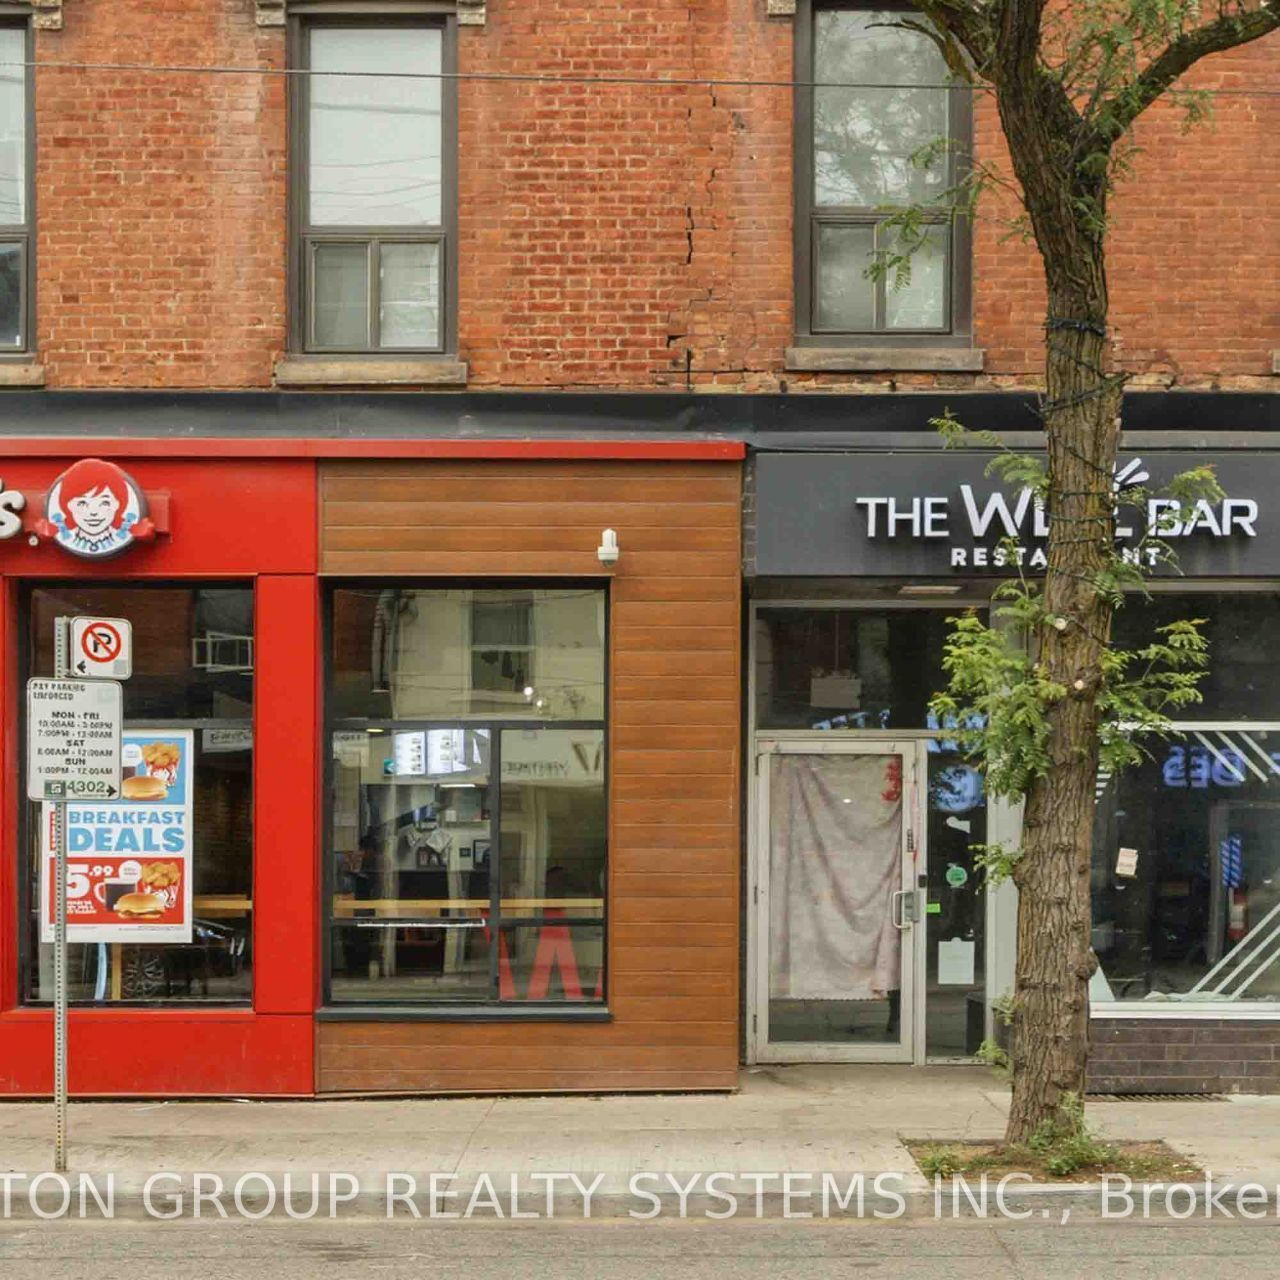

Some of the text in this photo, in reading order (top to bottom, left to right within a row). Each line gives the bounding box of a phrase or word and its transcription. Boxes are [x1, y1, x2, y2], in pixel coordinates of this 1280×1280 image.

[855, 497, 950, 538] THE
[1147, 498, 1259, 537] BAR
[951, 548, 1161, 567] RESTANT
[67, 781, 106, 793] 4302
[69, 811, 185, 824] BREAKFAST
[68, 827, 185, 852] DEALS
